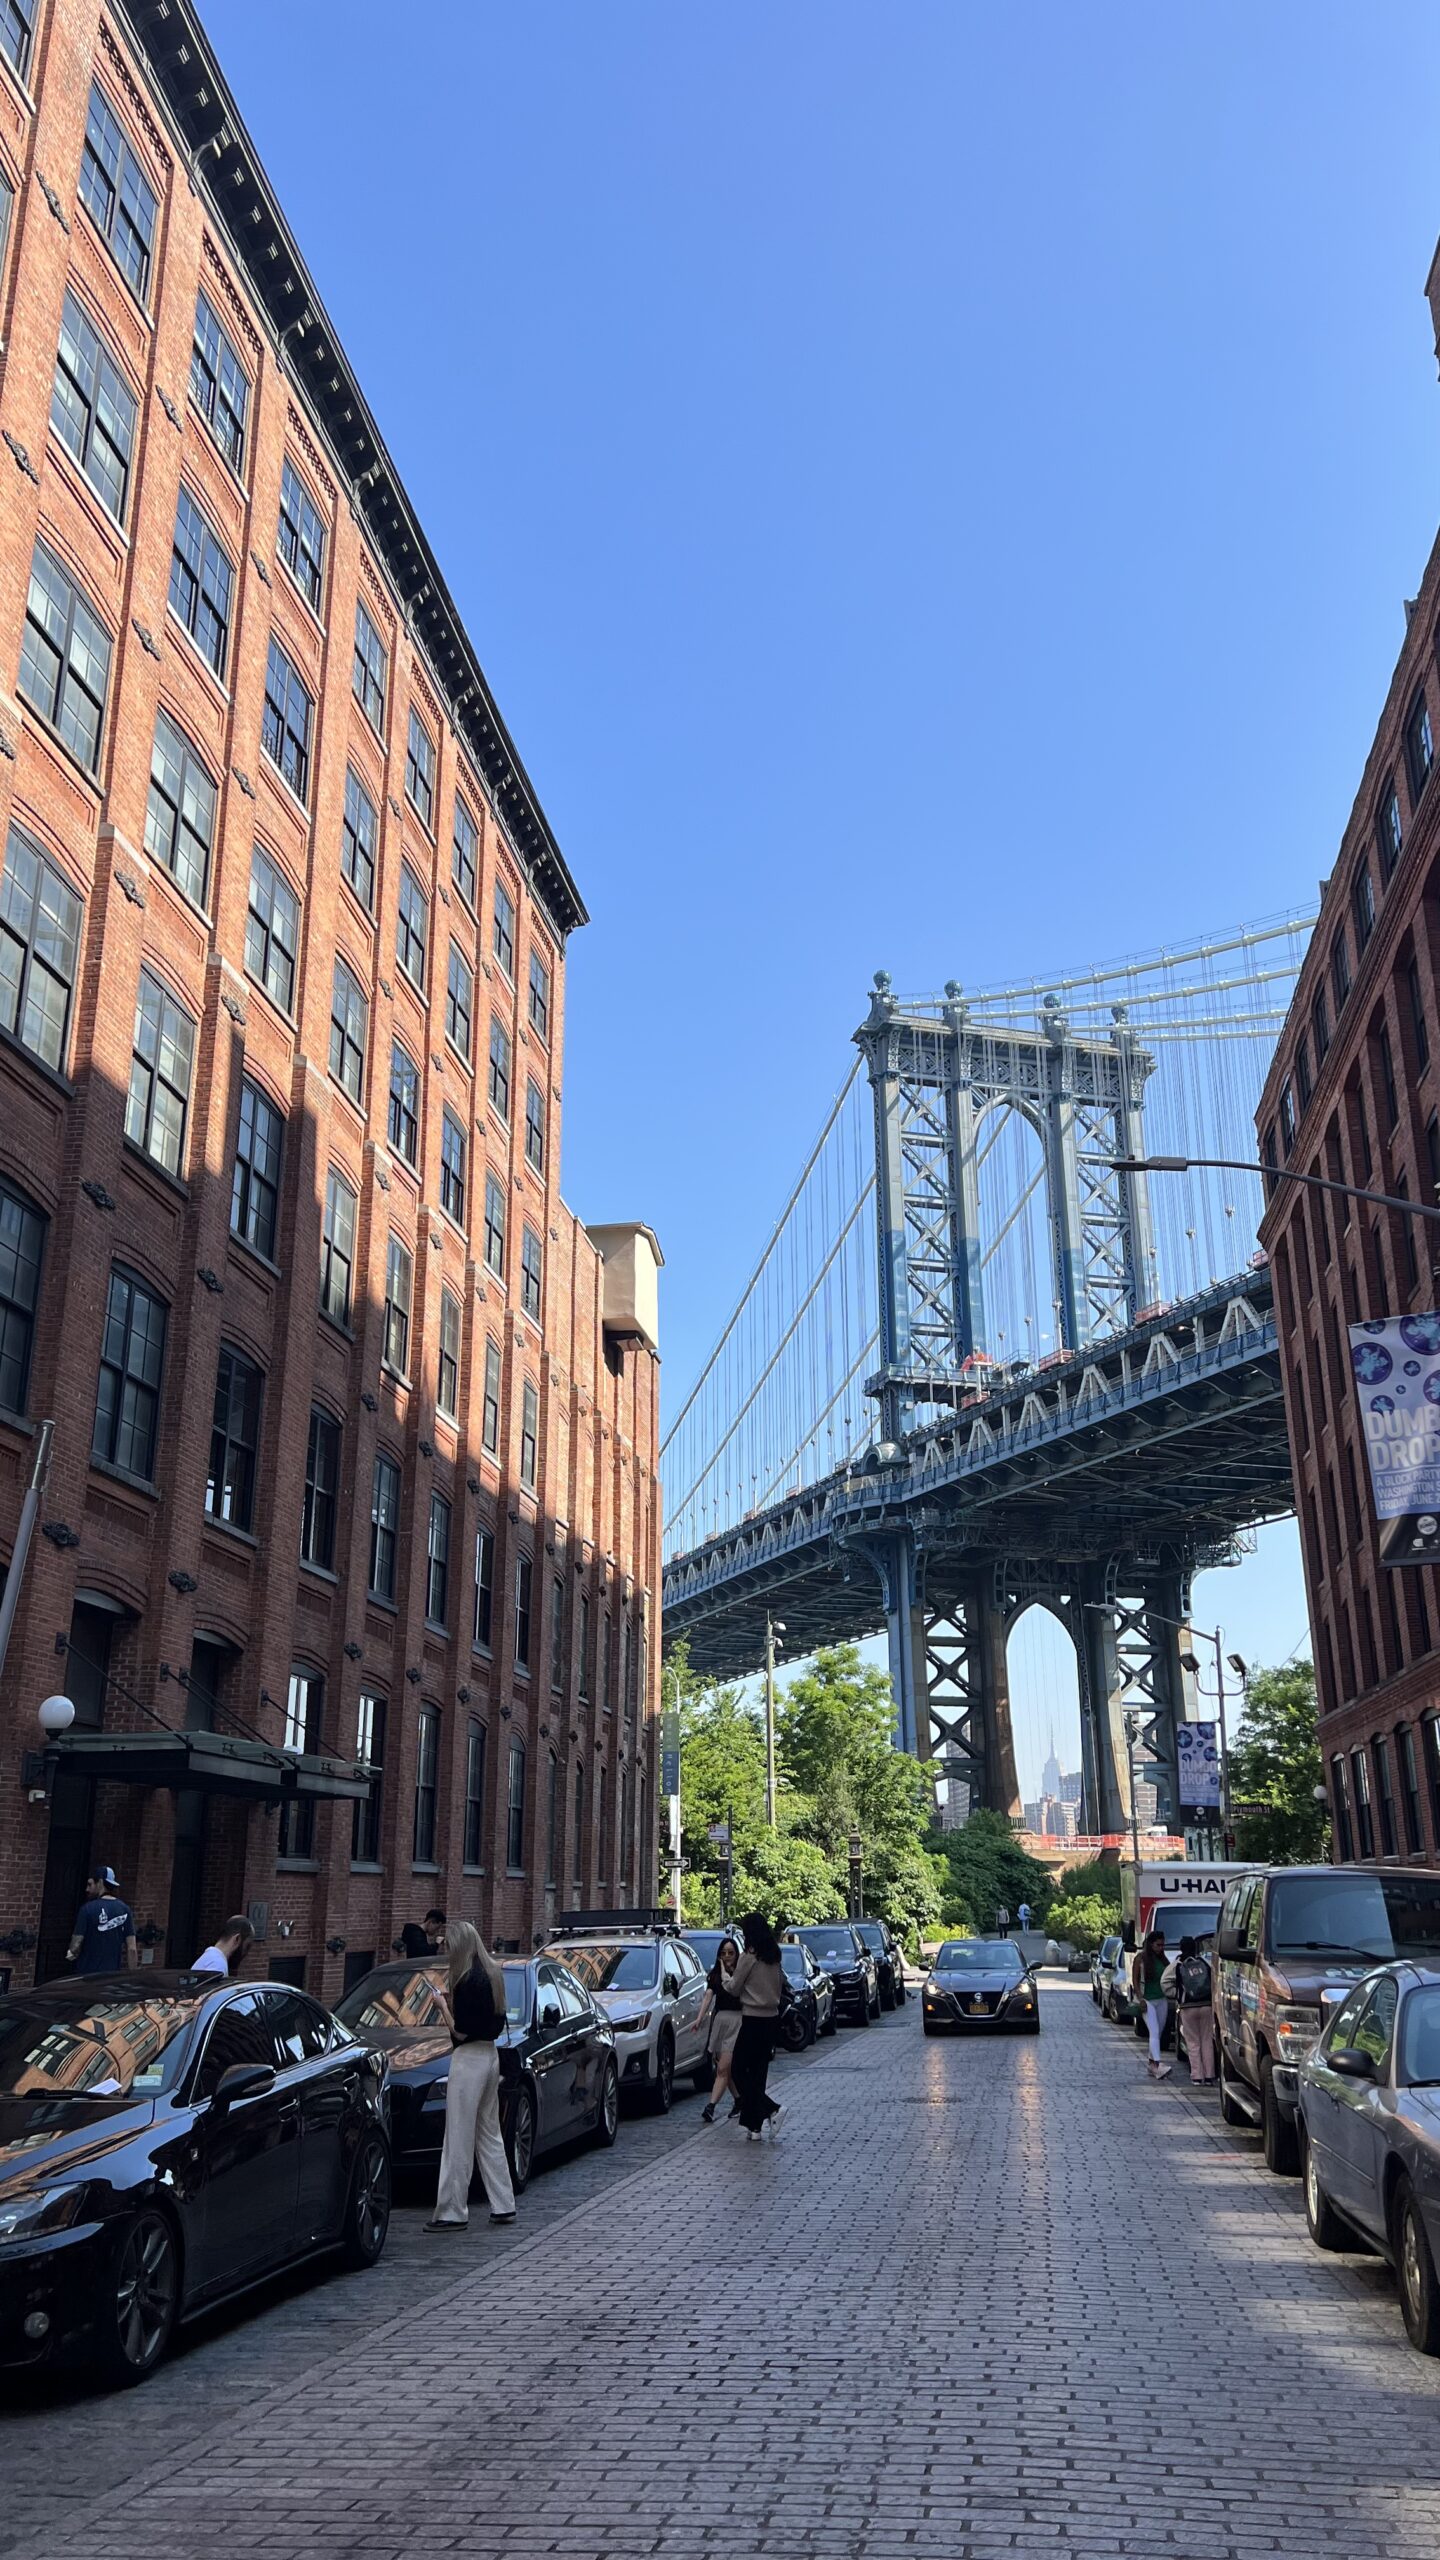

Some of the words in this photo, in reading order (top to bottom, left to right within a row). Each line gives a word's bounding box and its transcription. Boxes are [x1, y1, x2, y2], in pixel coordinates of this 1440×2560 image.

[1370, 1434, 1440, 1471] DROP
[1376, 1477, 1384, 1487] A
[1385, 1472, 1412, 1487] BLOCK
[1377, 1481, 1434, 1499] WASHINGTON
[1410, 1493, 1434, 1506] JUNE
[1180, 1760, 1217, 1773] DUMBO
[1181, 1772, 1210, 1785] DROP
[1232, 1805, 1263, 1814] Plymouth
[1263, 1806, 1271, 1814] St
